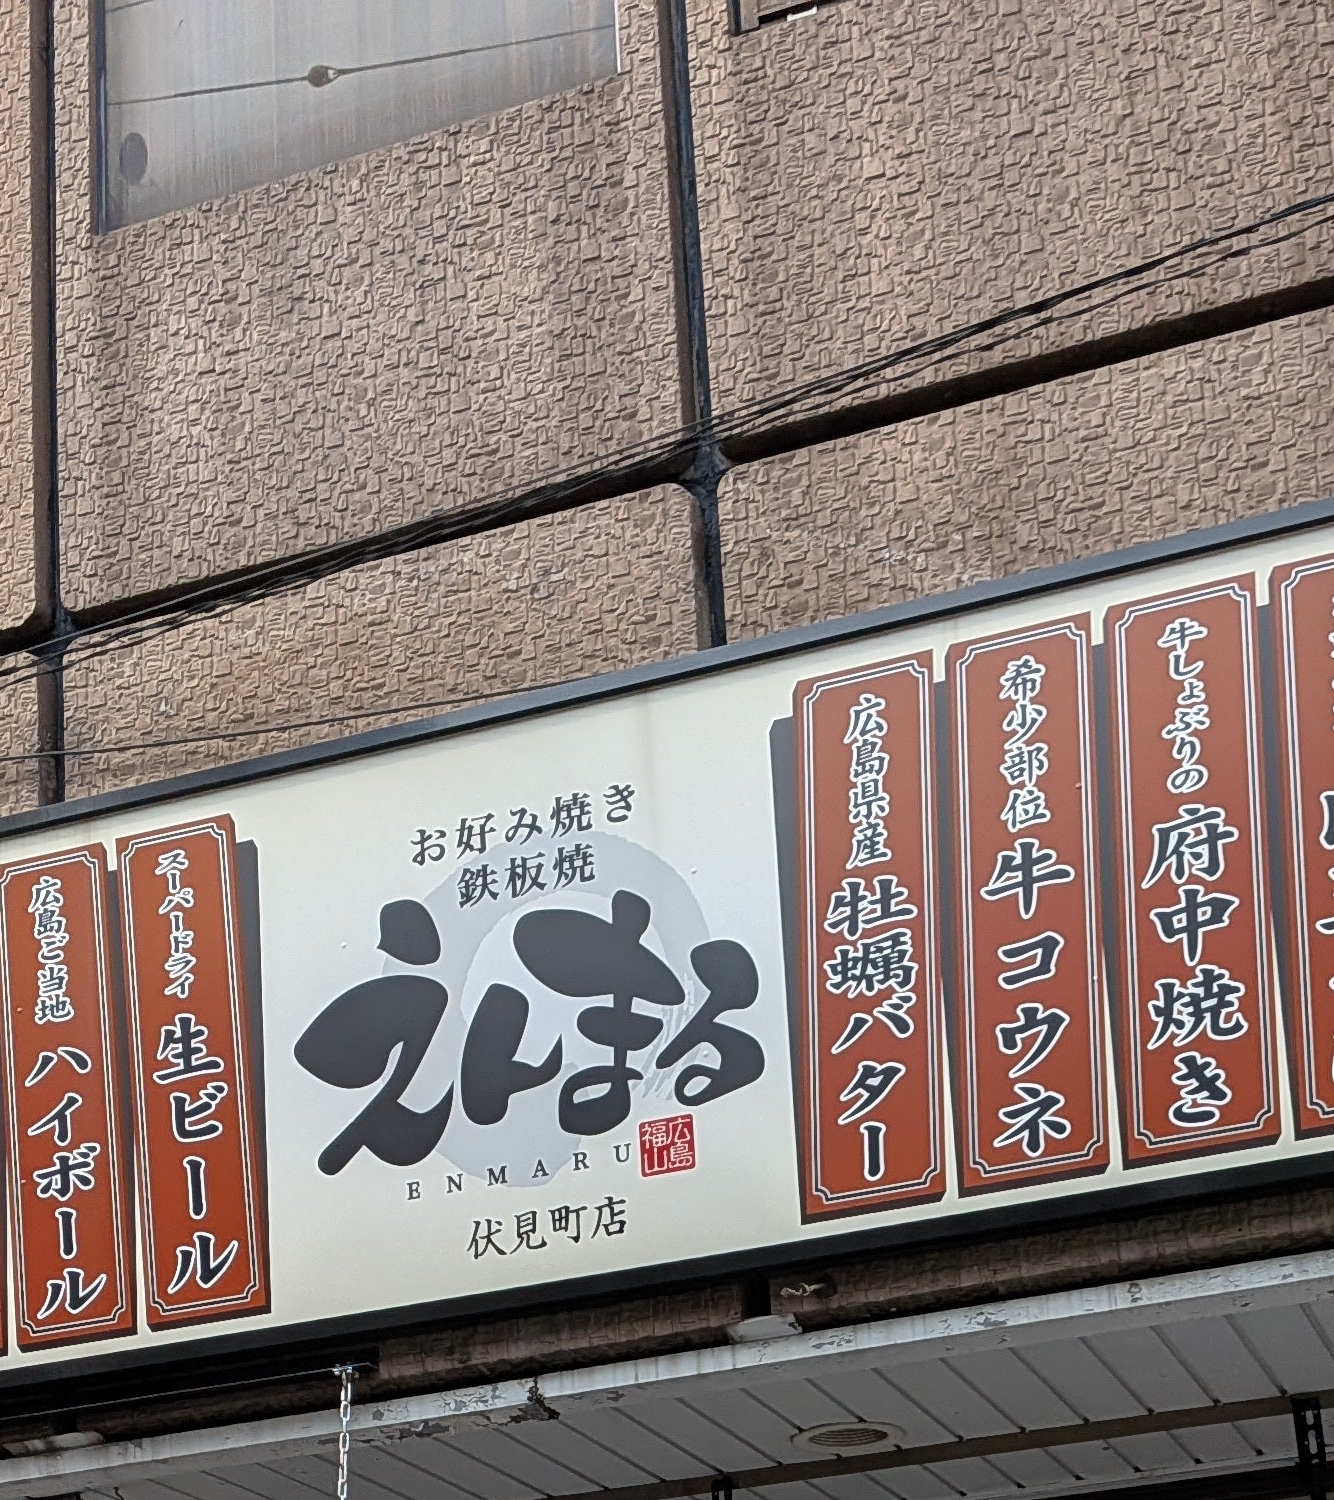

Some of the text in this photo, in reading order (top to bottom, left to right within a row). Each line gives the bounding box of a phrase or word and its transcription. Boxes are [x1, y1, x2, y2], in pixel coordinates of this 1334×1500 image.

[410, 784, 636, 866] お好み焼き
[457, 843, 596, 908] 鉄板焼
[823, 694, 918, 1181] 広島県産 牡蠣バター
[981, 655, 1075, 1157] 希少部位 牛コウネ
[1143, 617, 1249, 1127] 牛しょぶりの 府中焼き
[25, 876, 107, 1320] 広島ご当地 ハイボール
[154, 849, 239, 1296] スーパードライ 生ビール
[294, 889, 765, 1176] えんまる
[407, 1143, 631, 1201] ENMARU
[467, 1196, 627, 1260] 伏見町店
